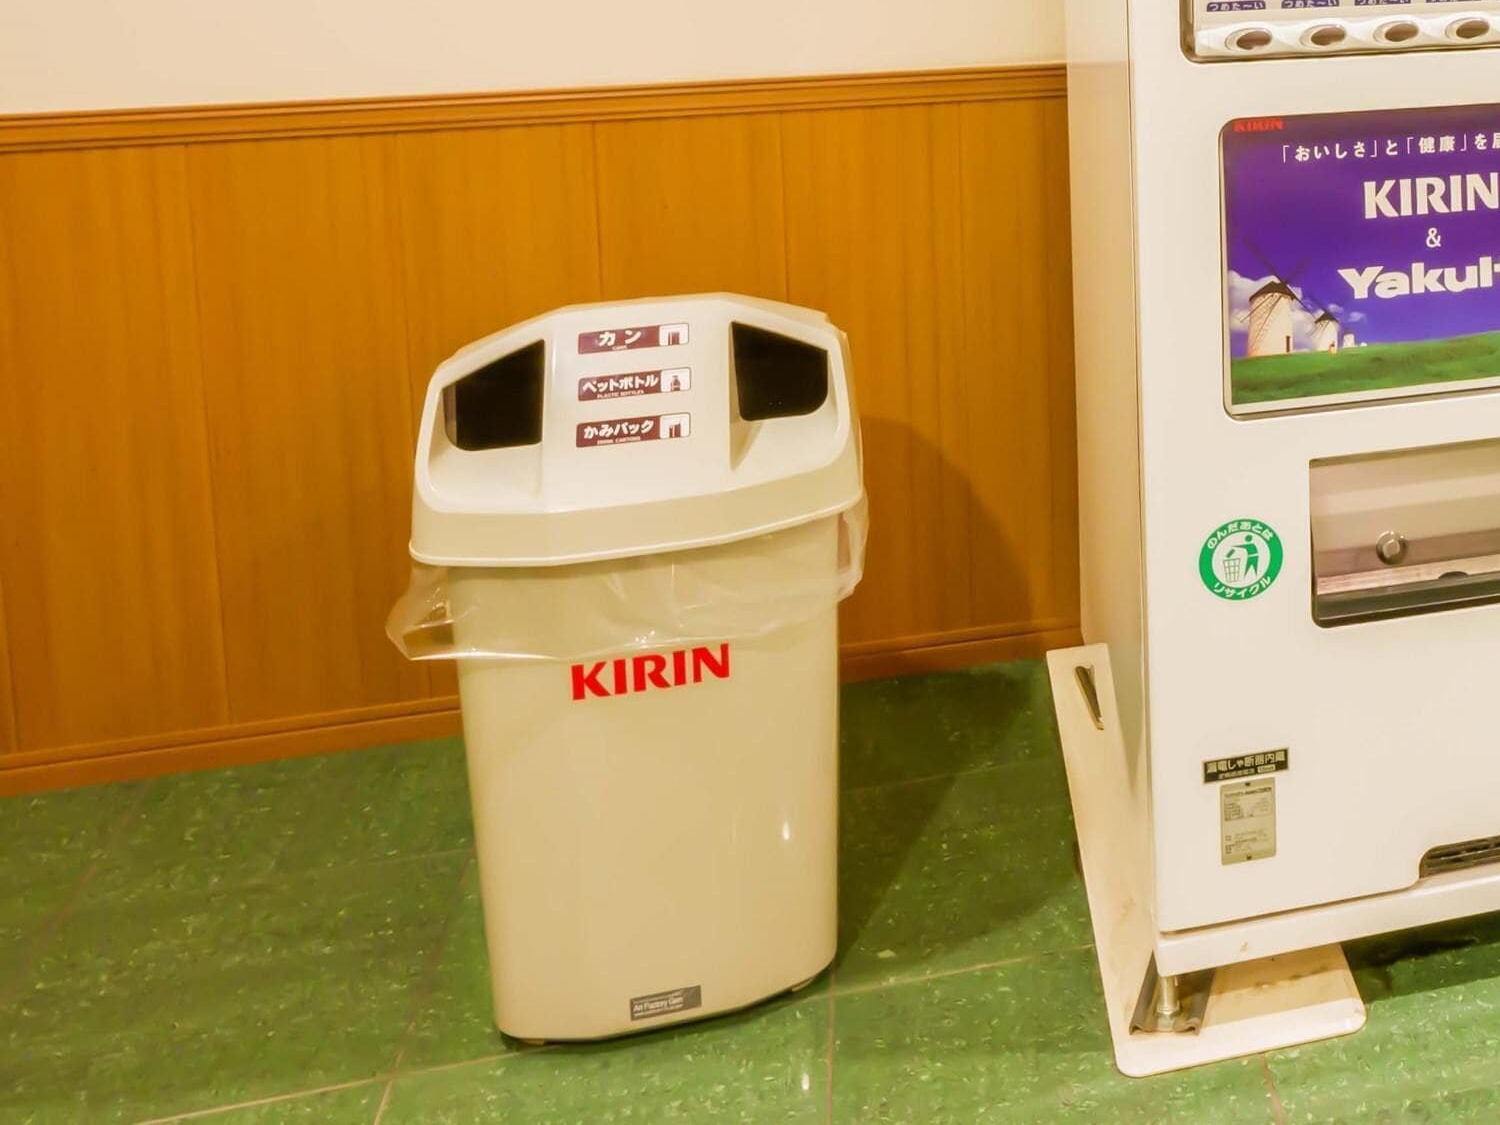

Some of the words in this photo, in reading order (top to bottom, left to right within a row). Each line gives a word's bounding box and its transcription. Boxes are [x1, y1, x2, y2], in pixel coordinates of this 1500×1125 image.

[1208, 1, 1265, 11] つめた〜い
[1363, 172, 1500, 220] KIRIN
[1425, 227, 1442, 248] &
[598, 329, 642, 347] カン
[582, 374, 659, 393] ペットボトル
[583, 419, 655, 440] かみパック
[1213, 575, 1272, 598] リサイクル
[570, 642, 730, 701] KIRIN
